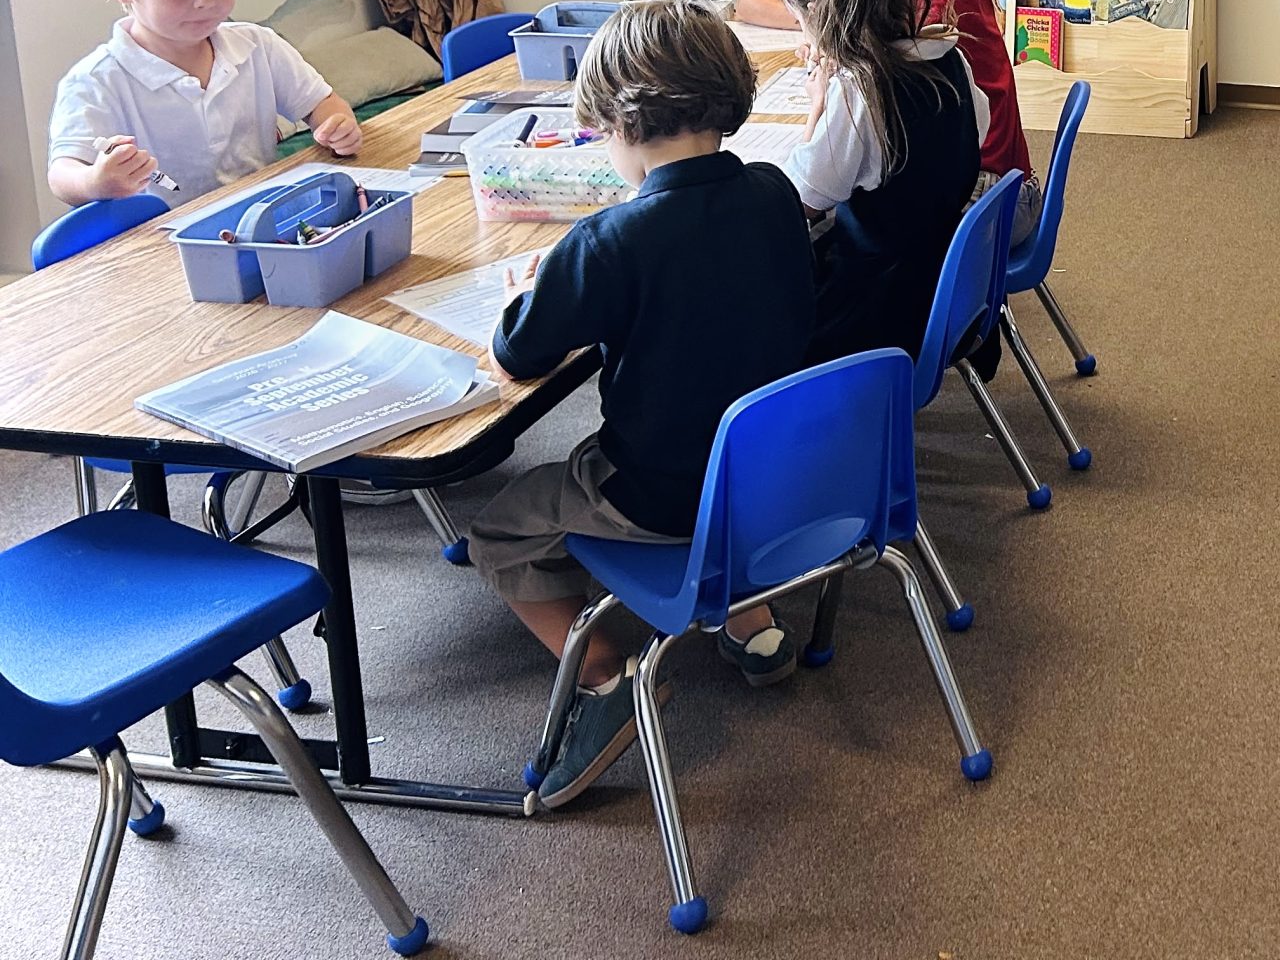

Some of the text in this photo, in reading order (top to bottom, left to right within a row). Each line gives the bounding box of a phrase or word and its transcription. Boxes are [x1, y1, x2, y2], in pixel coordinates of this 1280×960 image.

[1026, 18, 1050, 26] Chicka
[243, 364, 356, 407] September
[248, 376, 288, 392] Pre
[266, 373, 370, 412] Academic
[300, 387, 370, 412] Series
[298, 431, 334, 446] Social
[378, 408, 401, 417] and
